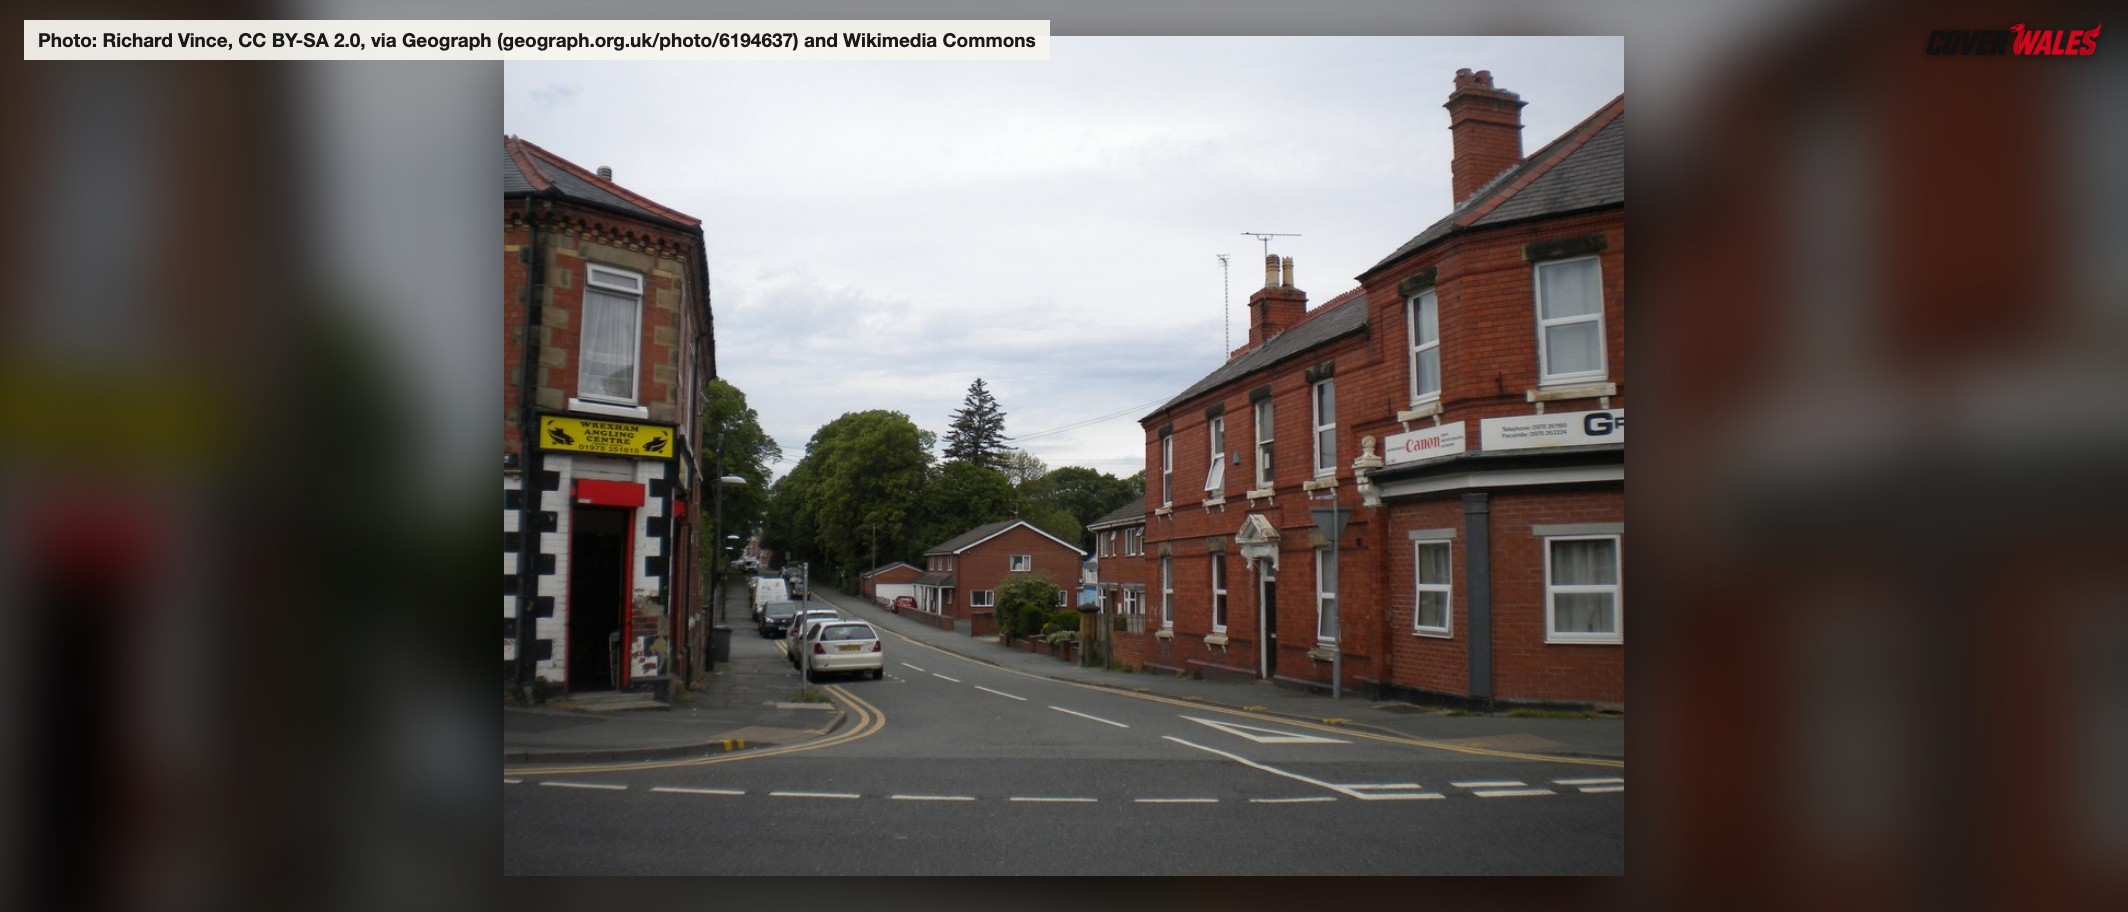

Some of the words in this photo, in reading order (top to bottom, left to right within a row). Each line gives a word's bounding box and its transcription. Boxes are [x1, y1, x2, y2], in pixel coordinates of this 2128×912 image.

[580, 421, 639, 432] WREXHAM
[584, 429, 635, 439] ANGLING
[586, 436, 631, 444] CENTRE
[1405, 436, 1440, 453] Canon
